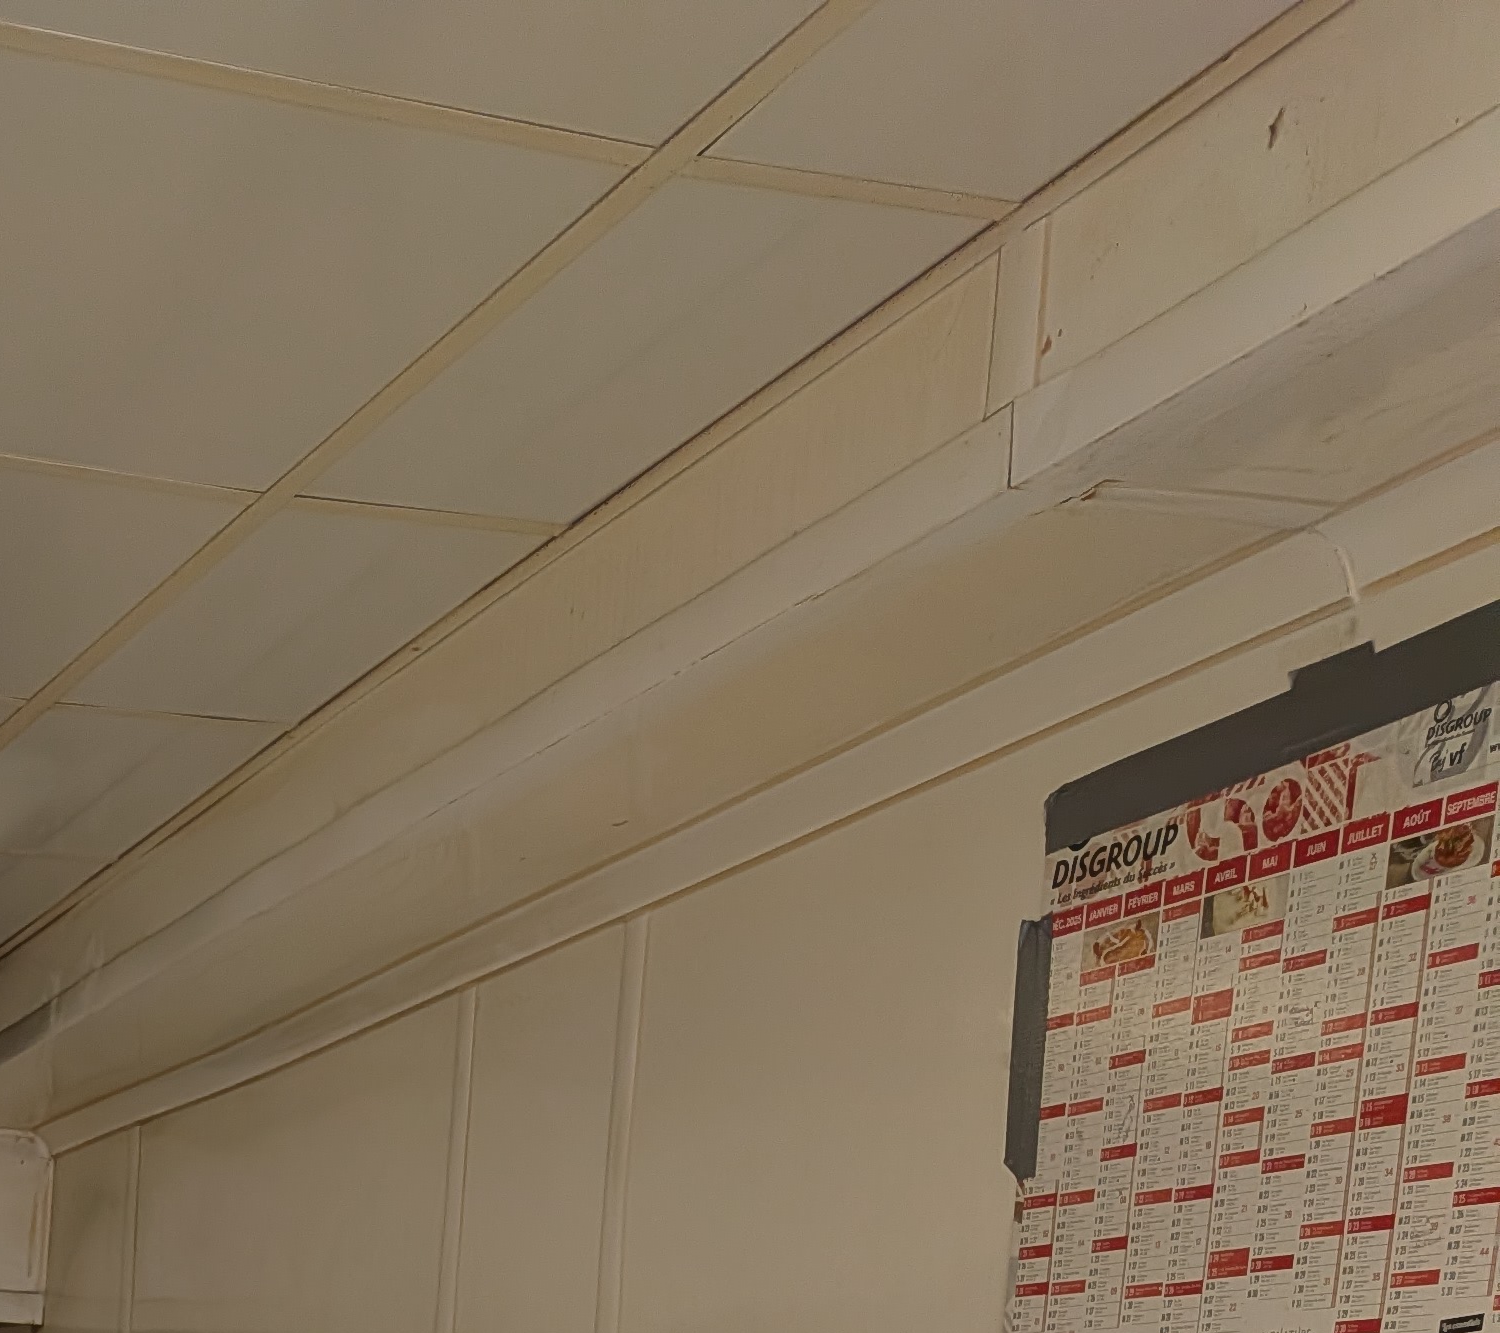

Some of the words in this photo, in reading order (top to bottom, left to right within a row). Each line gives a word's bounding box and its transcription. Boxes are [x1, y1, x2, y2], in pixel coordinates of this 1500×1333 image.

[1427, 708, 1492, 740] DISGROUP
[1403, 810, 1431, 828] AOÛT
[1347, 824, 1384, 845] JUILLET
[1052, 824, 1179, 889] DISGROUP
[1307, 842, 1326, 857] JUIN
[1262, 855, 1278, 869] MAI
[1214, 868, 1237, 884] AVRIL
[1172, 882, 1195, 895] MARS
[1089, 903, 1118, 922] JANVIER
[1385, 1168, 1393, 1177] 34
